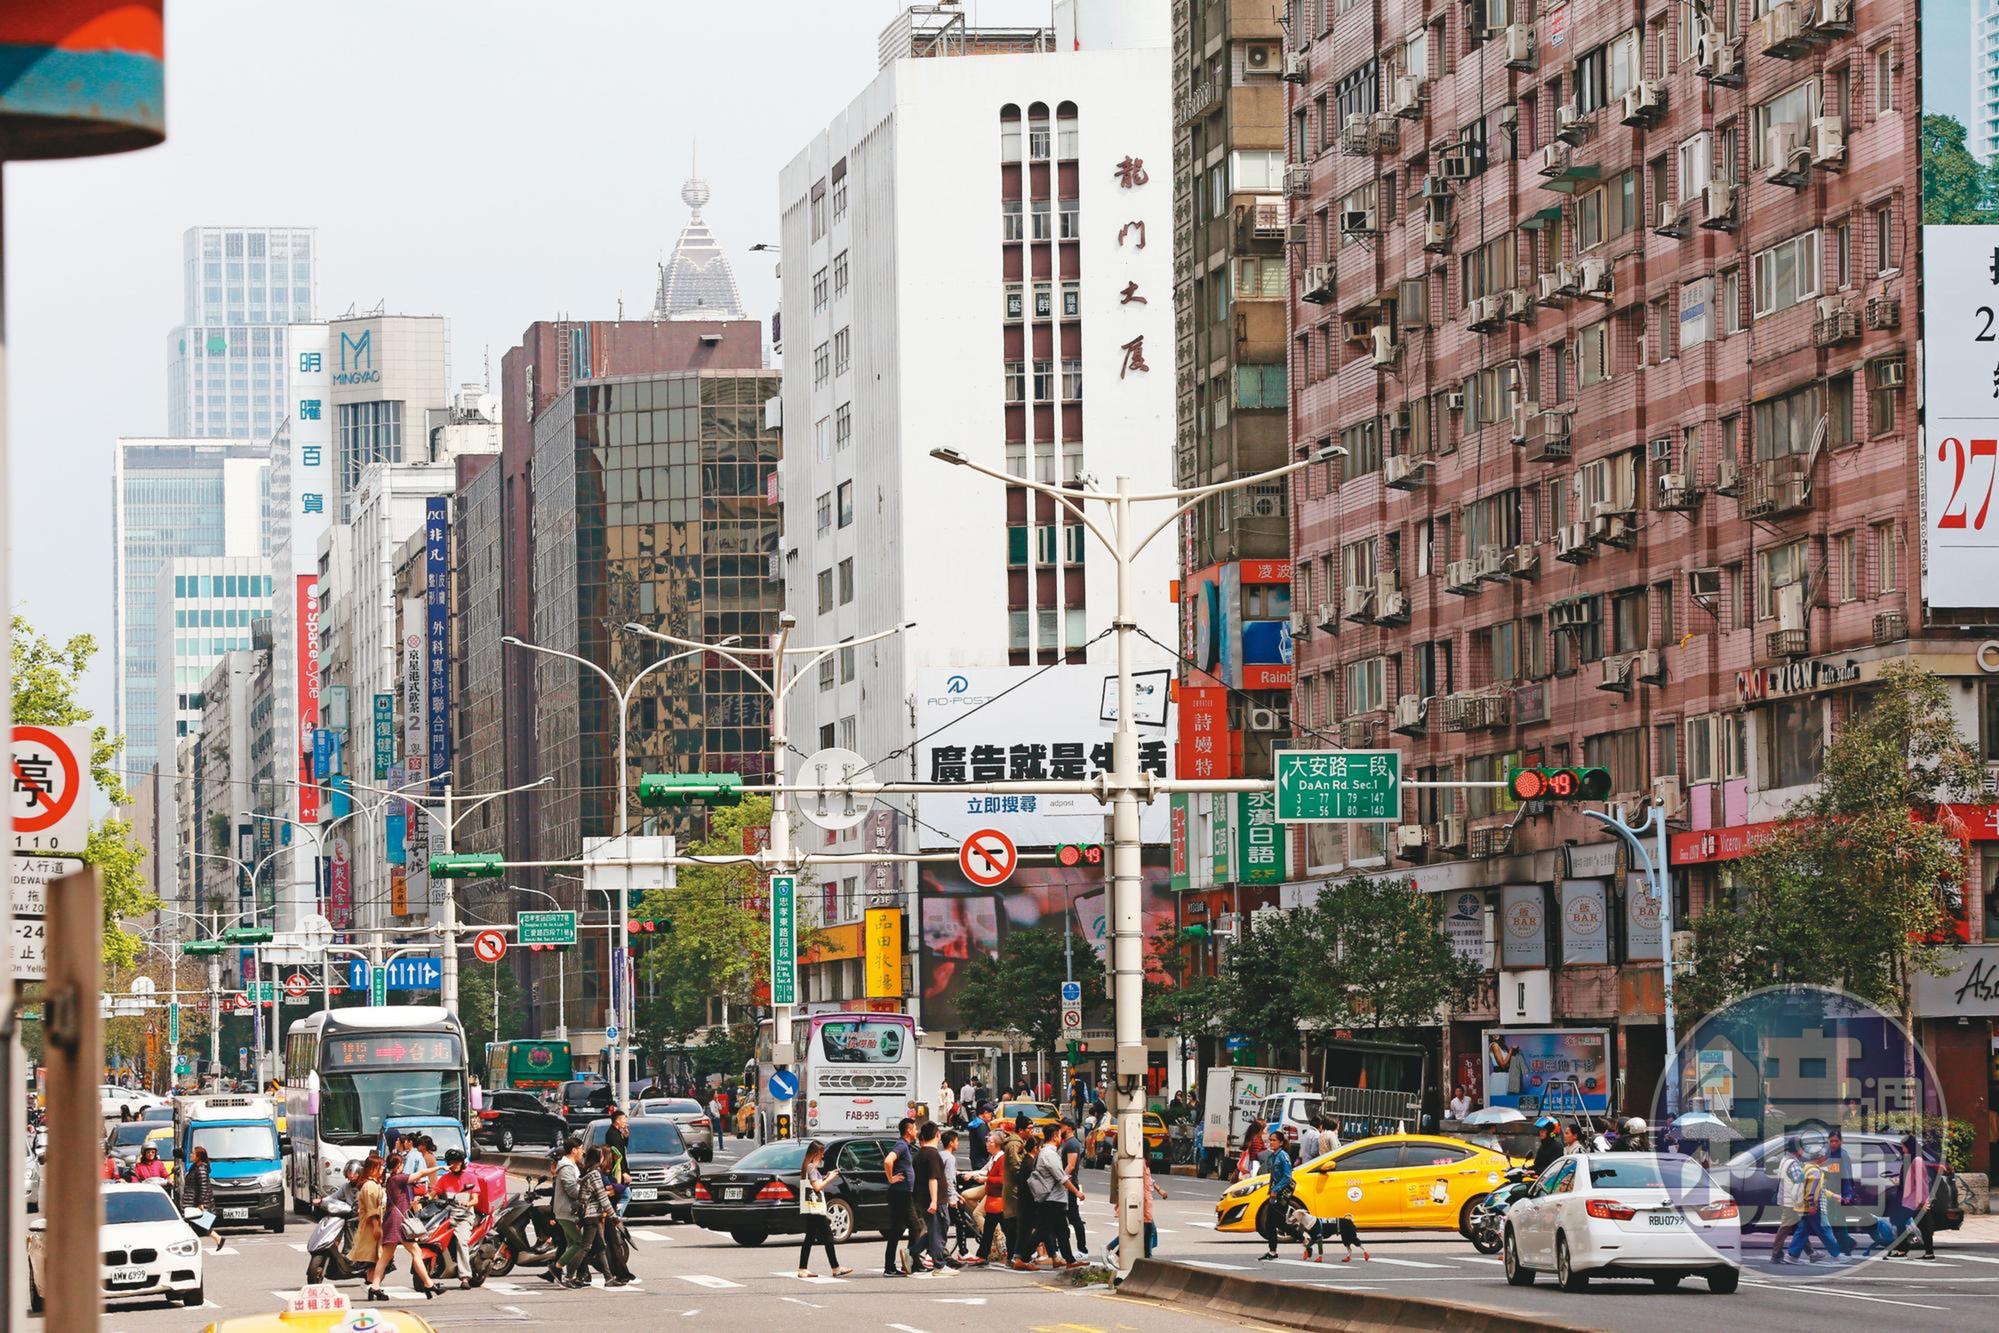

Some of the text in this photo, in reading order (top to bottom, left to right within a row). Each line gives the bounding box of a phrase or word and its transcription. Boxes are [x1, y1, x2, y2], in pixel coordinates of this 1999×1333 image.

[332, 370, 381, 386] MINGYAO
[300, 352, 324, 514] 明曜百貨
[429, 527, 444, 561] 非凡
[432, 620, 446, 770] 外科專科聯合門診
[408, 715, 421, 731] 2
[376, 722, 392, 769] 復健科
[1289, 756, 1388, 778] 大安路一段
[1299, 780, 1378, 790] DaAn Rd. Sec.1
[967, 795, 1038, 814] 立即搜尋
[1050, 799, 1075, 808] adpost
[1319, 793, 1329, 804] 77
[1347, 793, 1358, 804] 79
[1513, 917, 1537, 926] BAR
[1573, 913, 1598, 922] BAR
[845, 1110, 880, 1120] FAB-995
[294, 1297, 345, 1311] 出租汽車
